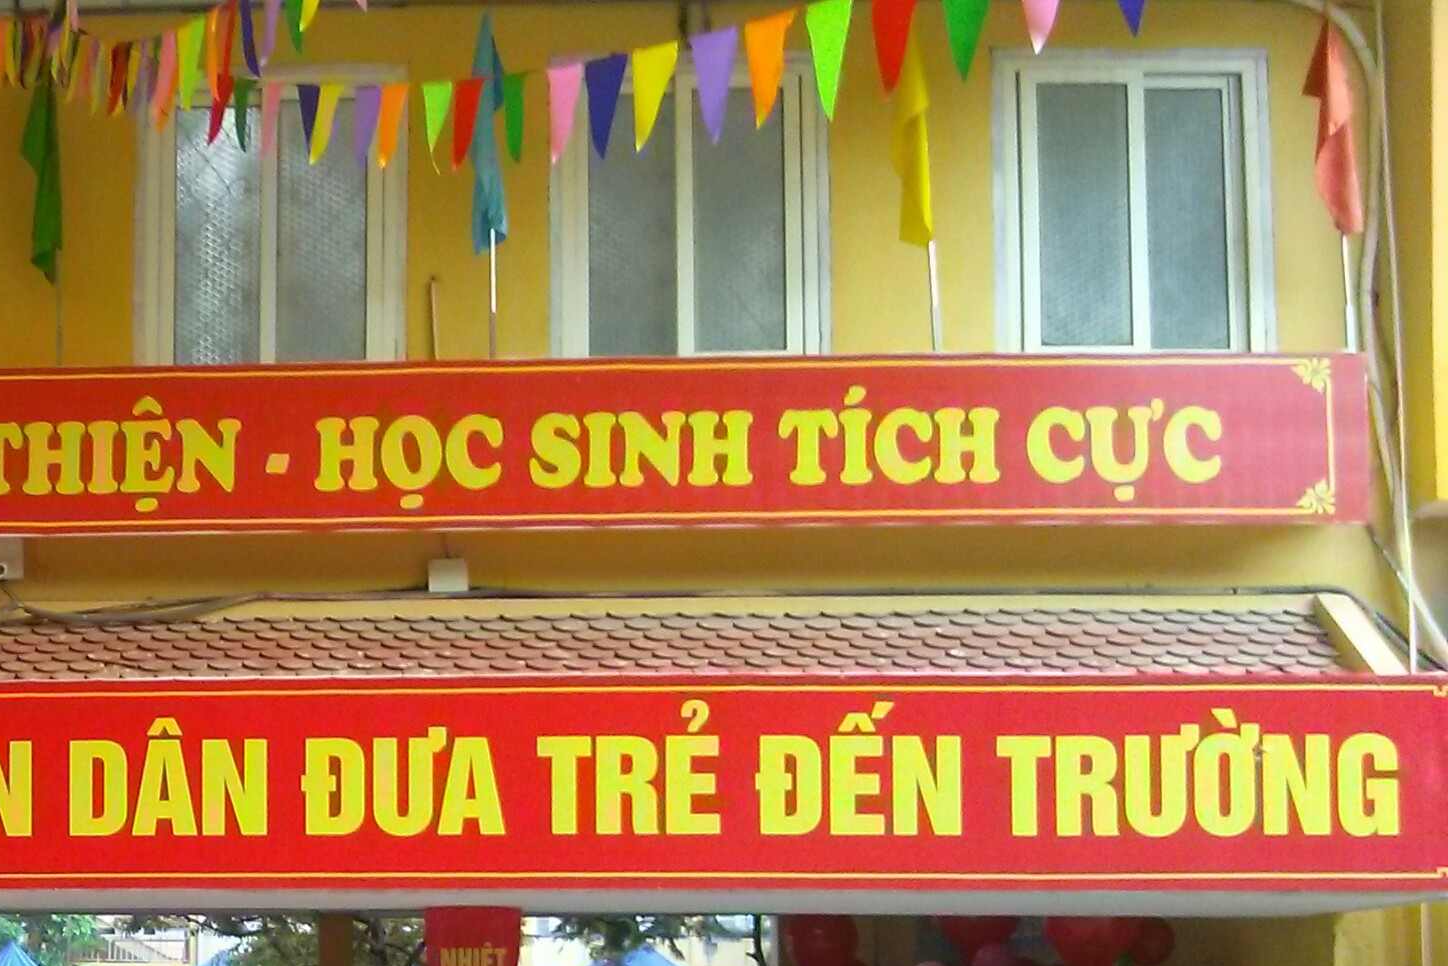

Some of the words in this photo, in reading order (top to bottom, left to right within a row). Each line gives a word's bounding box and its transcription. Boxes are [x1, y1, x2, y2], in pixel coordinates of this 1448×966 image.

[315, 414, 505, 510] HỌC
[529, 411, 754, 488] SINH
[778, 385, 1001, 486] TÍCH
[1026, 398, 1223, 502] CỰC
[69, 717, 268, 837] DÂN
[301, 726, 506, 837] ĐƯA
[536, 700, 721, 836] TRẺ
[754, 701, 963, 836] ĐẾN
[995, 707, 1401, 837] TRƯỜNG
